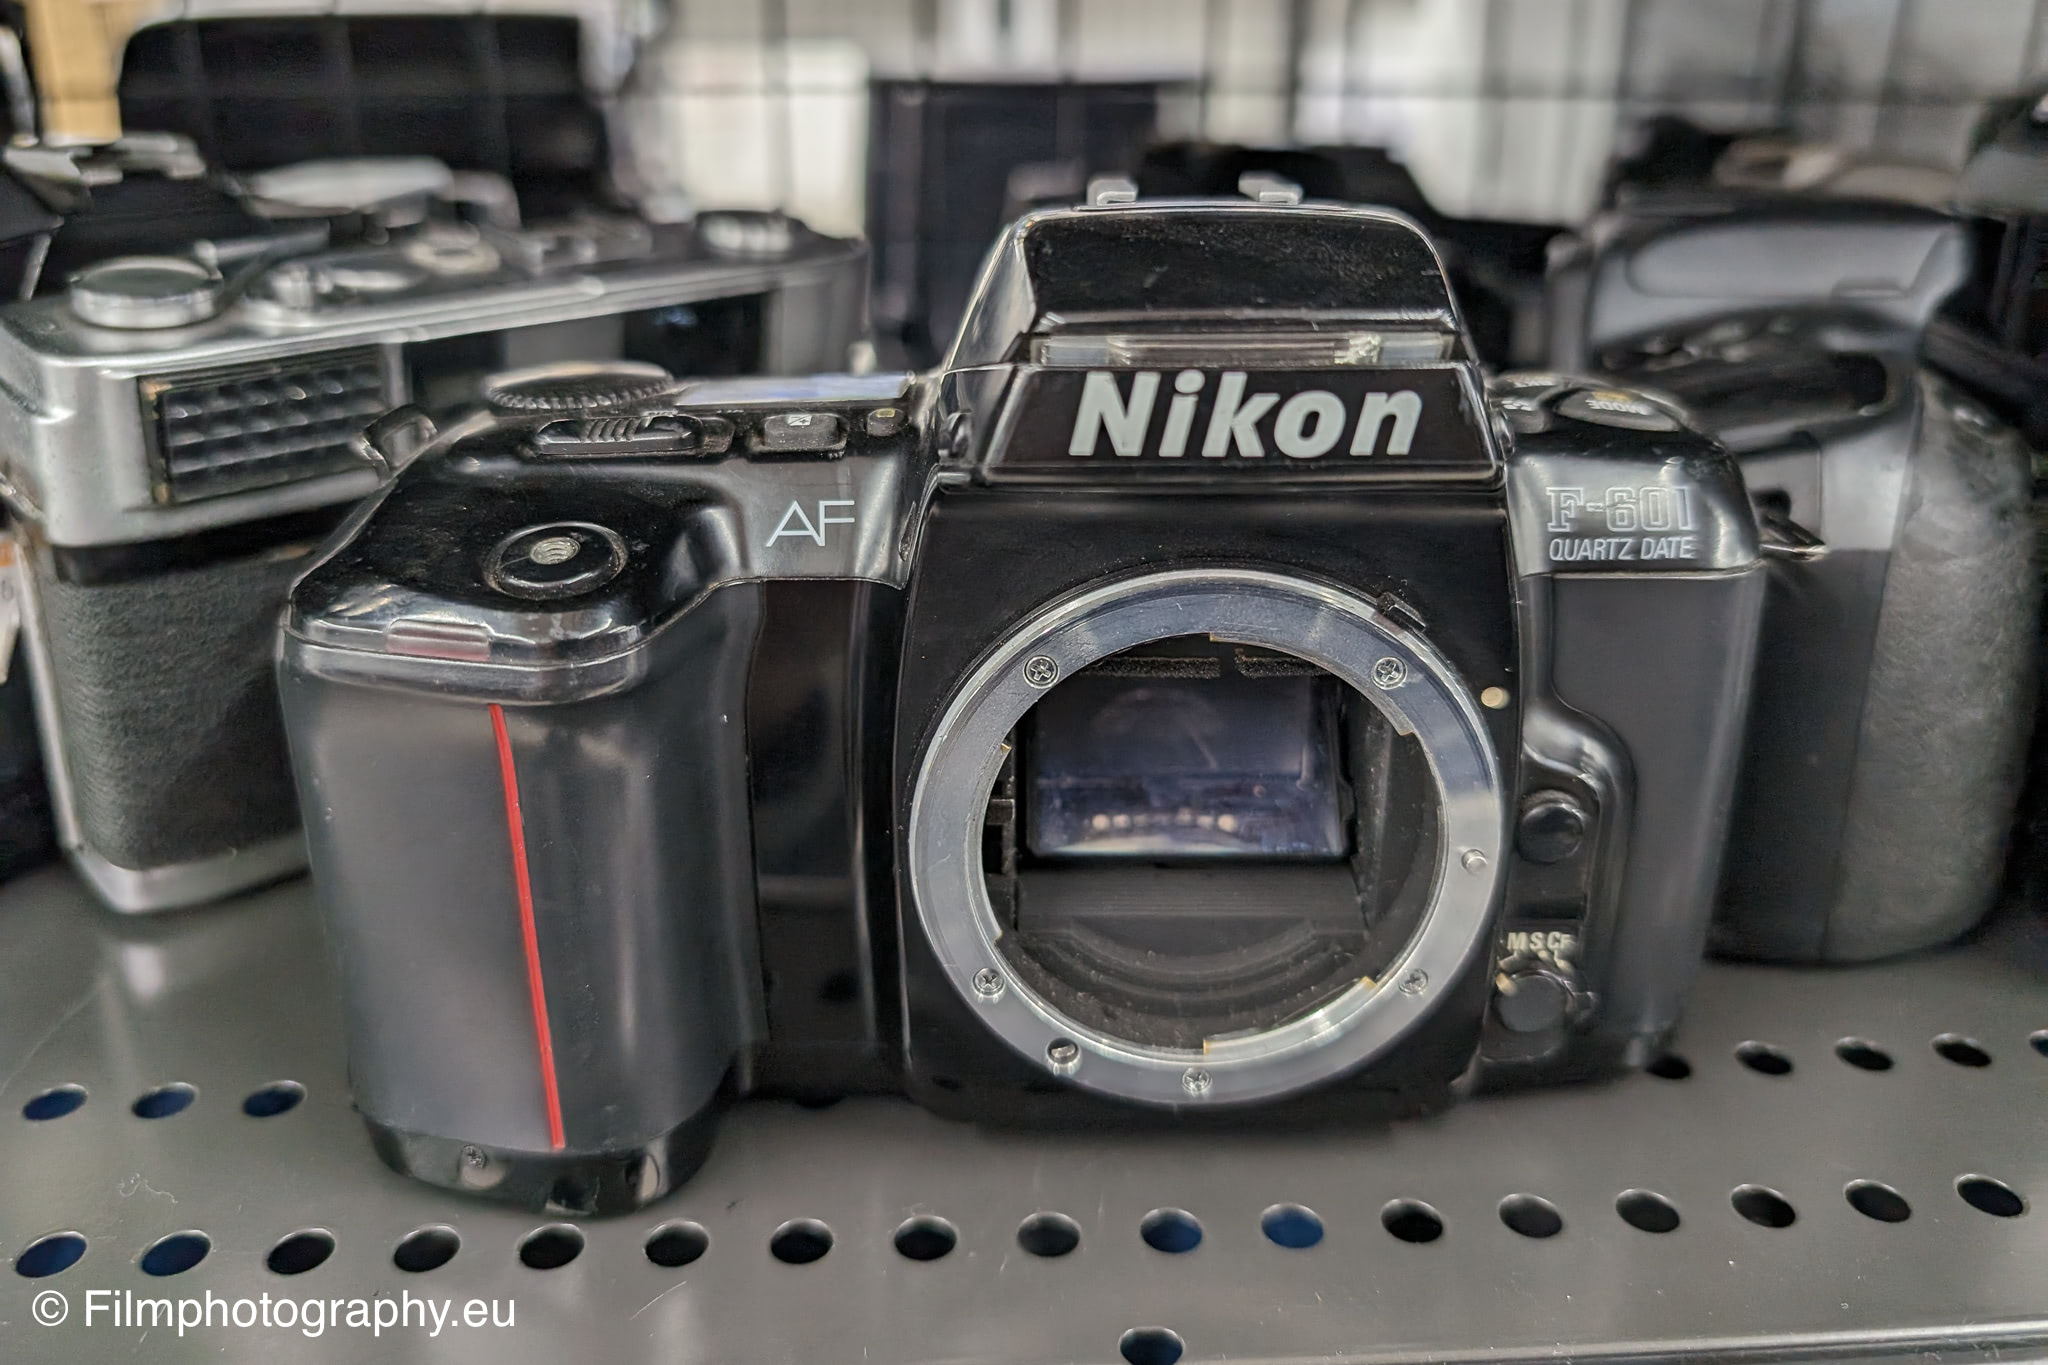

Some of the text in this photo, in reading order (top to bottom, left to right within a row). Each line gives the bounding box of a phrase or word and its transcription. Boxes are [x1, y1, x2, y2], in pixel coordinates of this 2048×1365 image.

[1068, 369, 1422, 458] Nikon
[766, 500, 855, 547] AF
[1546, 486, 1694, 532] F-601
[1549, 535, 1697, 561] QUARTZ DATE
